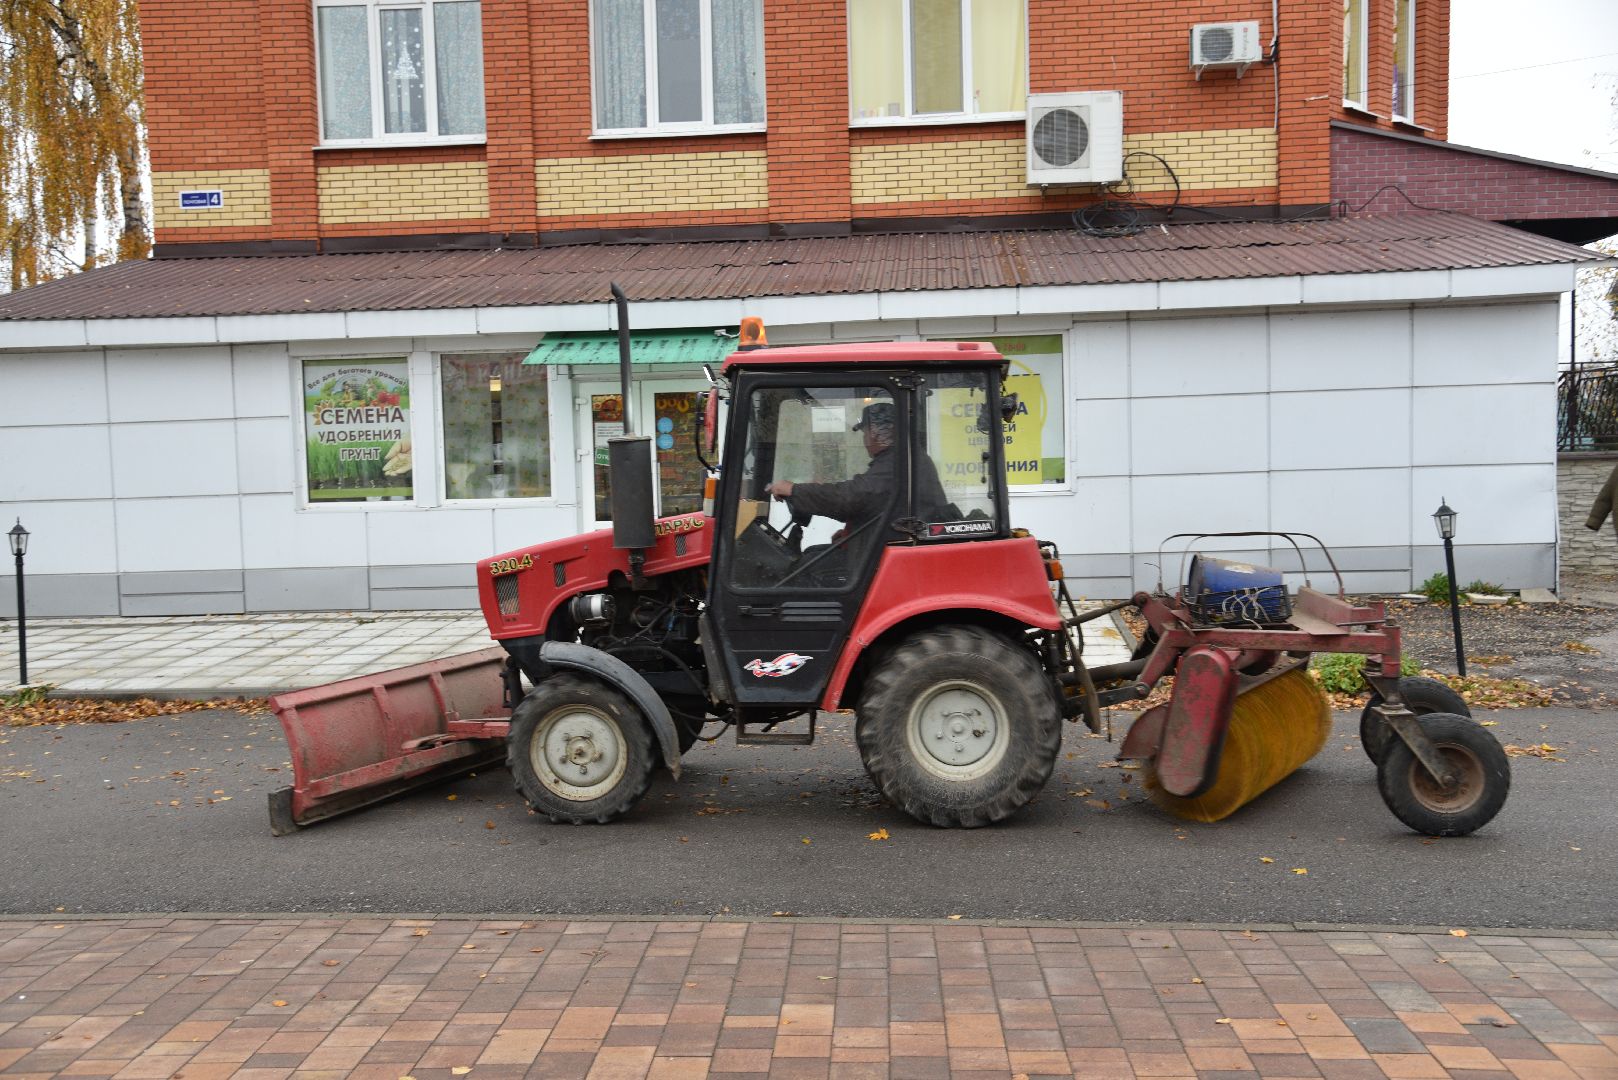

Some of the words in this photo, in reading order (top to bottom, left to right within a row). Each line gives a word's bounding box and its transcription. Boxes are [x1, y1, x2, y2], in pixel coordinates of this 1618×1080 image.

[211, 194, 219, 204] 4
[307, 379, 321, 390] Все
[322, 372, 336, 381] для
[338, 367, 372, 376] богатого
[374, 369, 406, 386] урожая!
[320, 407, 405, 425] СЕМЕНА
[318, 429, 402, 444] УДОБРЕНИЯ
[341, 448, 381, 461] ГРУНТ
[944, 523, 993, 534] YOKOHAMA
[490, 553, 534, 575] 320.4
